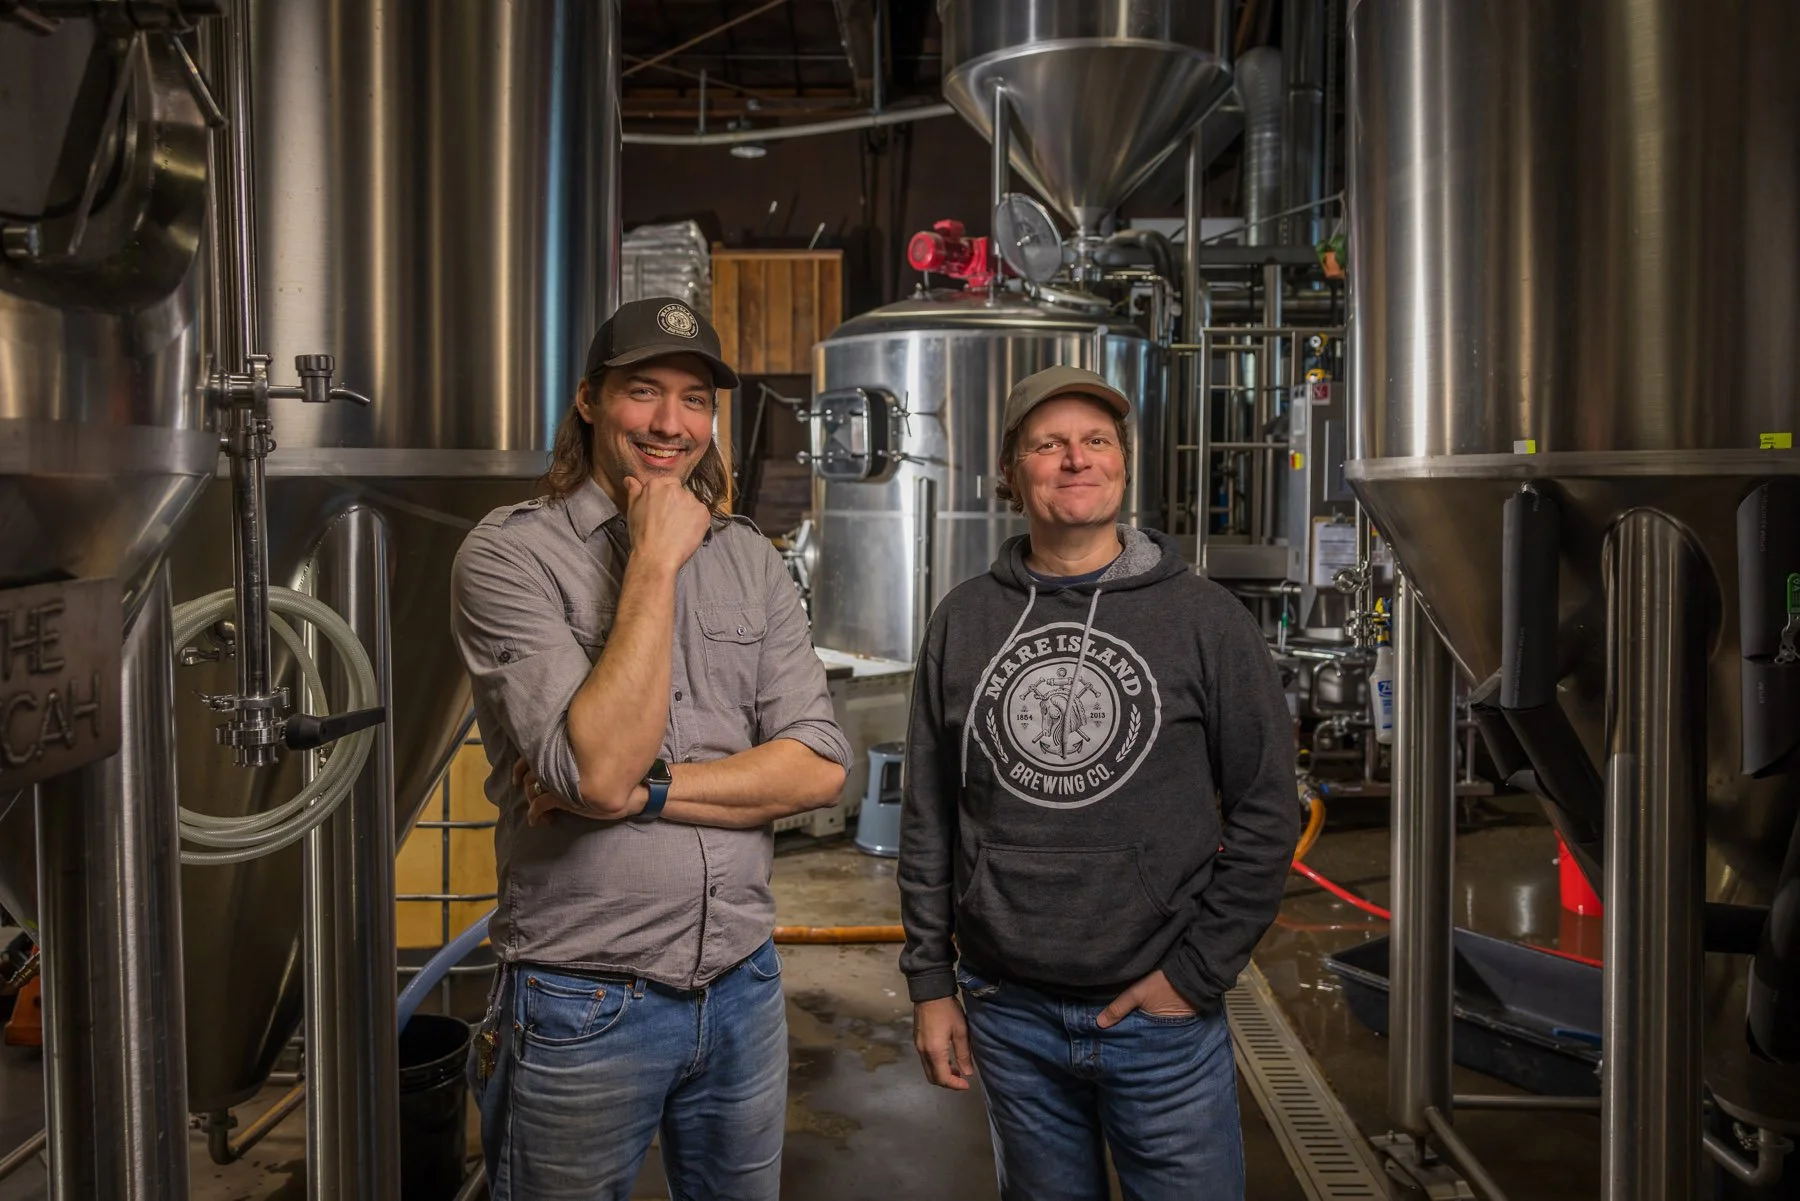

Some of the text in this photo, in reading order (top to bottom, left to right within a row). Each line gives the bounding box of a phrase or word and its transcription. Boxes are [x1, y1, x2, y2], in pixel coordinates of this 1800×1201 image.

[0, 599, 65, 682] HE
[985, 634, 1142, 701] MARE ISLAND
[1009, 761, 1115, 795] BREWING CO.
